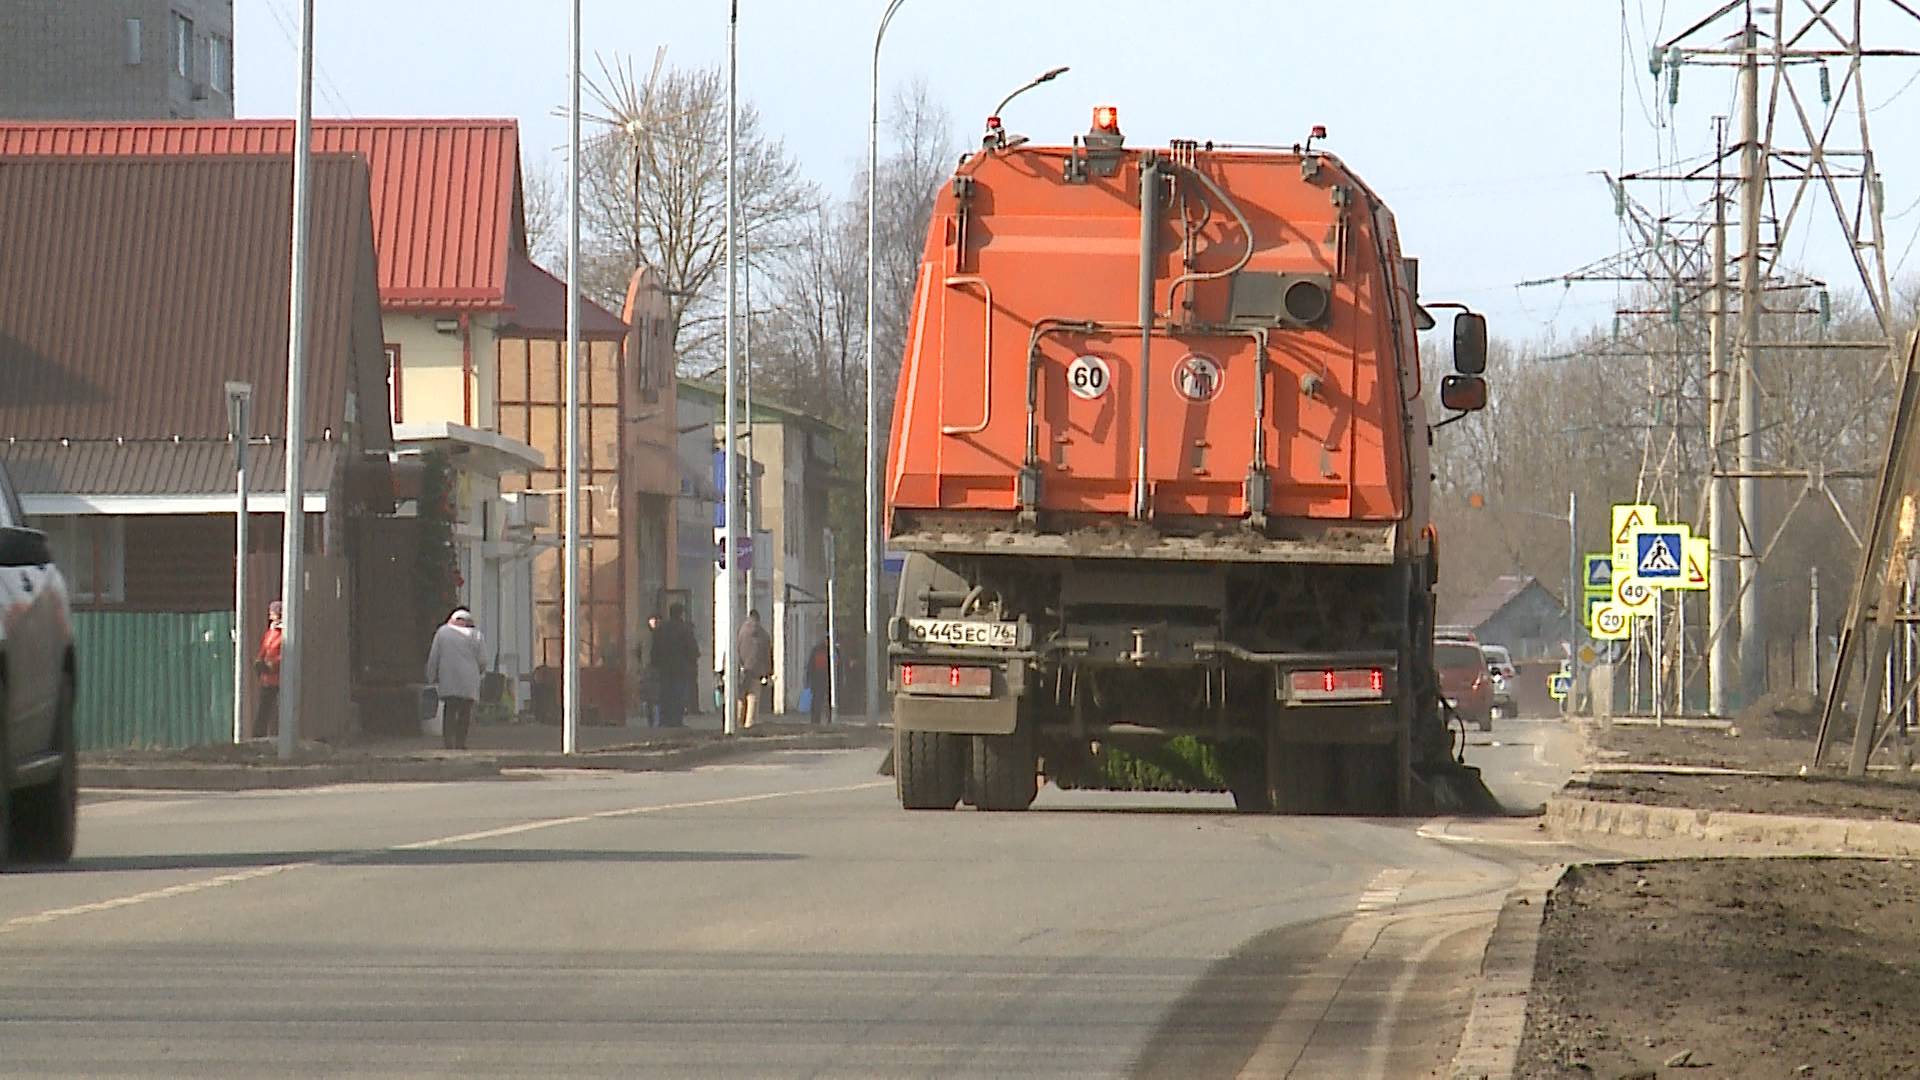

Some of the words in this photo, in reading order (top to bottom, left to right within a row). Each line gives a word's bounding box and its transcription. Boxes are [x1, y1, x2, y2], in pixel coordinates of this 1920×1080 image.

[1074, 367, 1103, 388] 60
[1624, 585, 1644, 598] 40
[1604, 615, 1620, 627] 20
